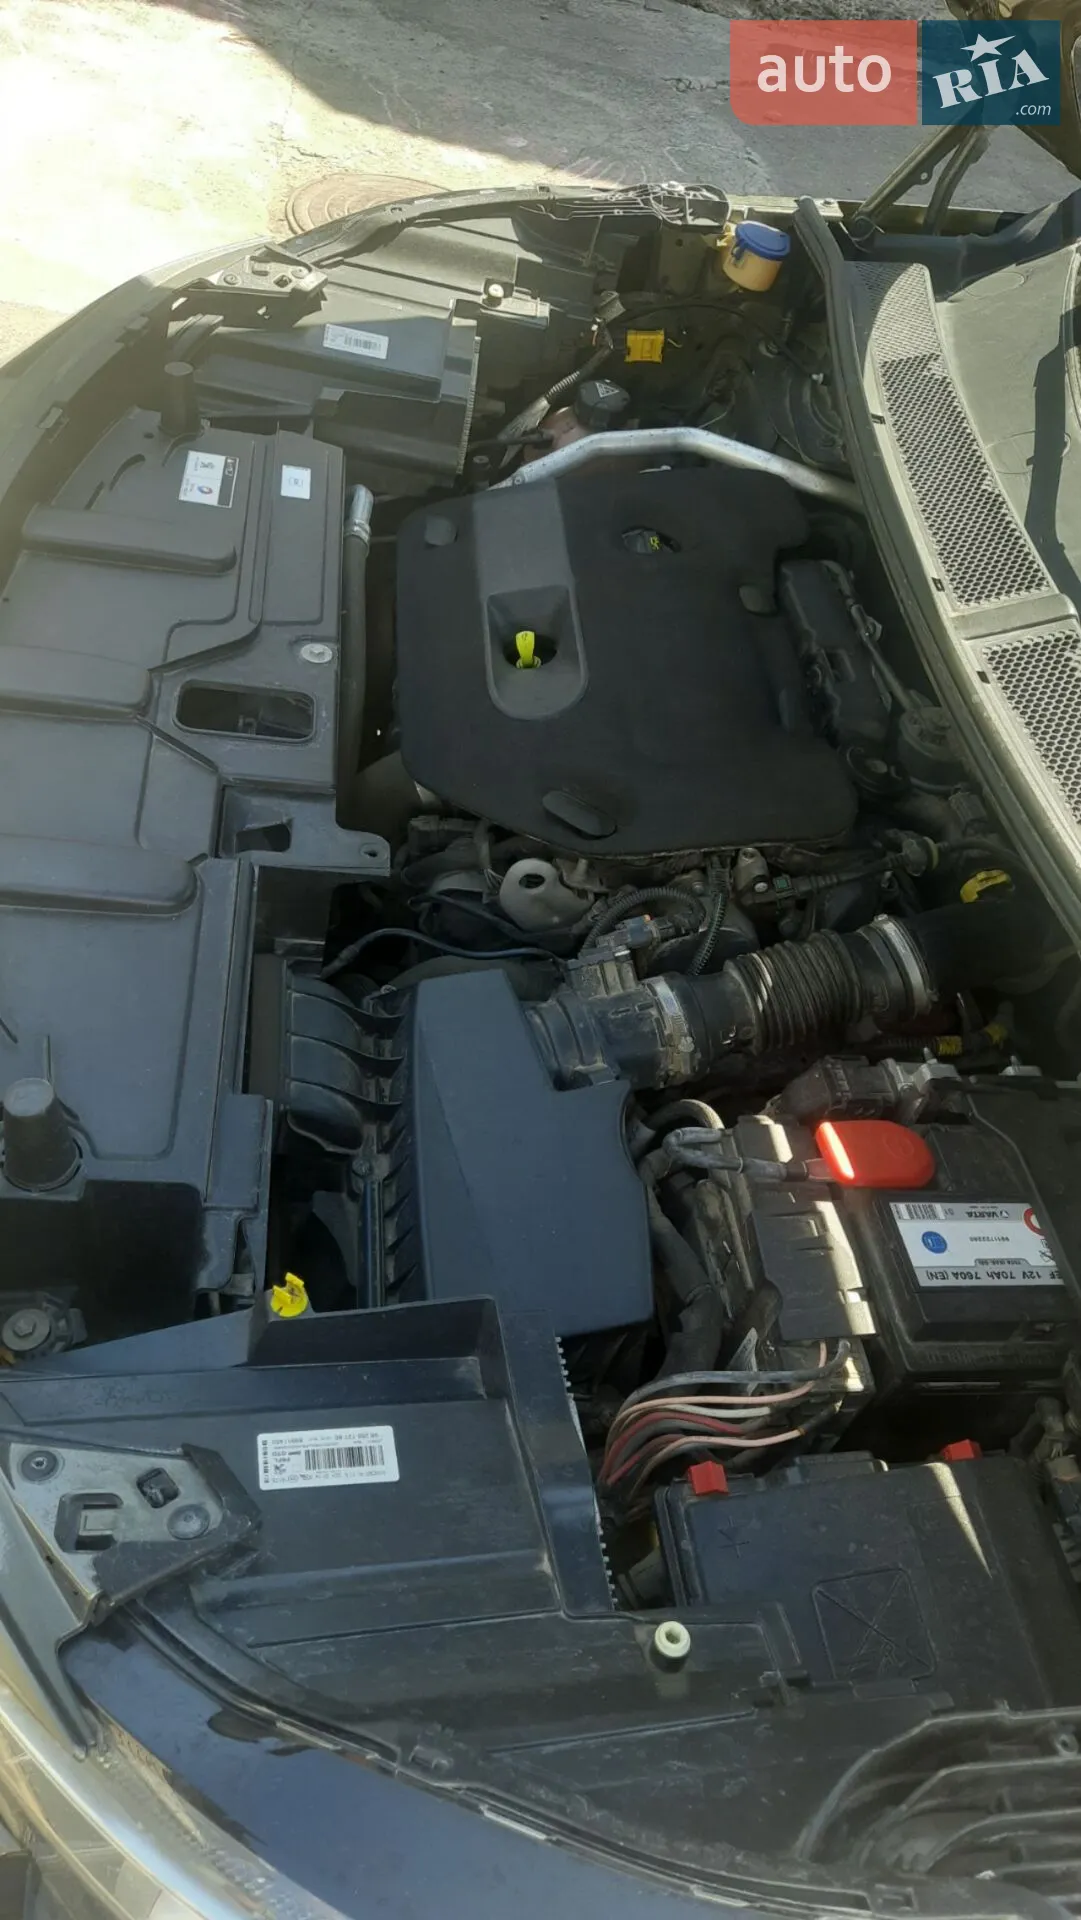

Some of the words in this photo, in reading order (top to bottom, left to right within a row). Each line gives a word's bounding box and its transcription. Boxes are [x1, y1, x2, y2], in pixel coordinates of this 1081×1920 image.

[966, 1210, 1000, 1218] VARTA
[926, 1270, 949, 1281] (EN)
[952, 1270, 981, 1280] 760A
[986, 1270, 1017, 1280] 70Ah
[1022, 1270, 1042, 1279] 12V
